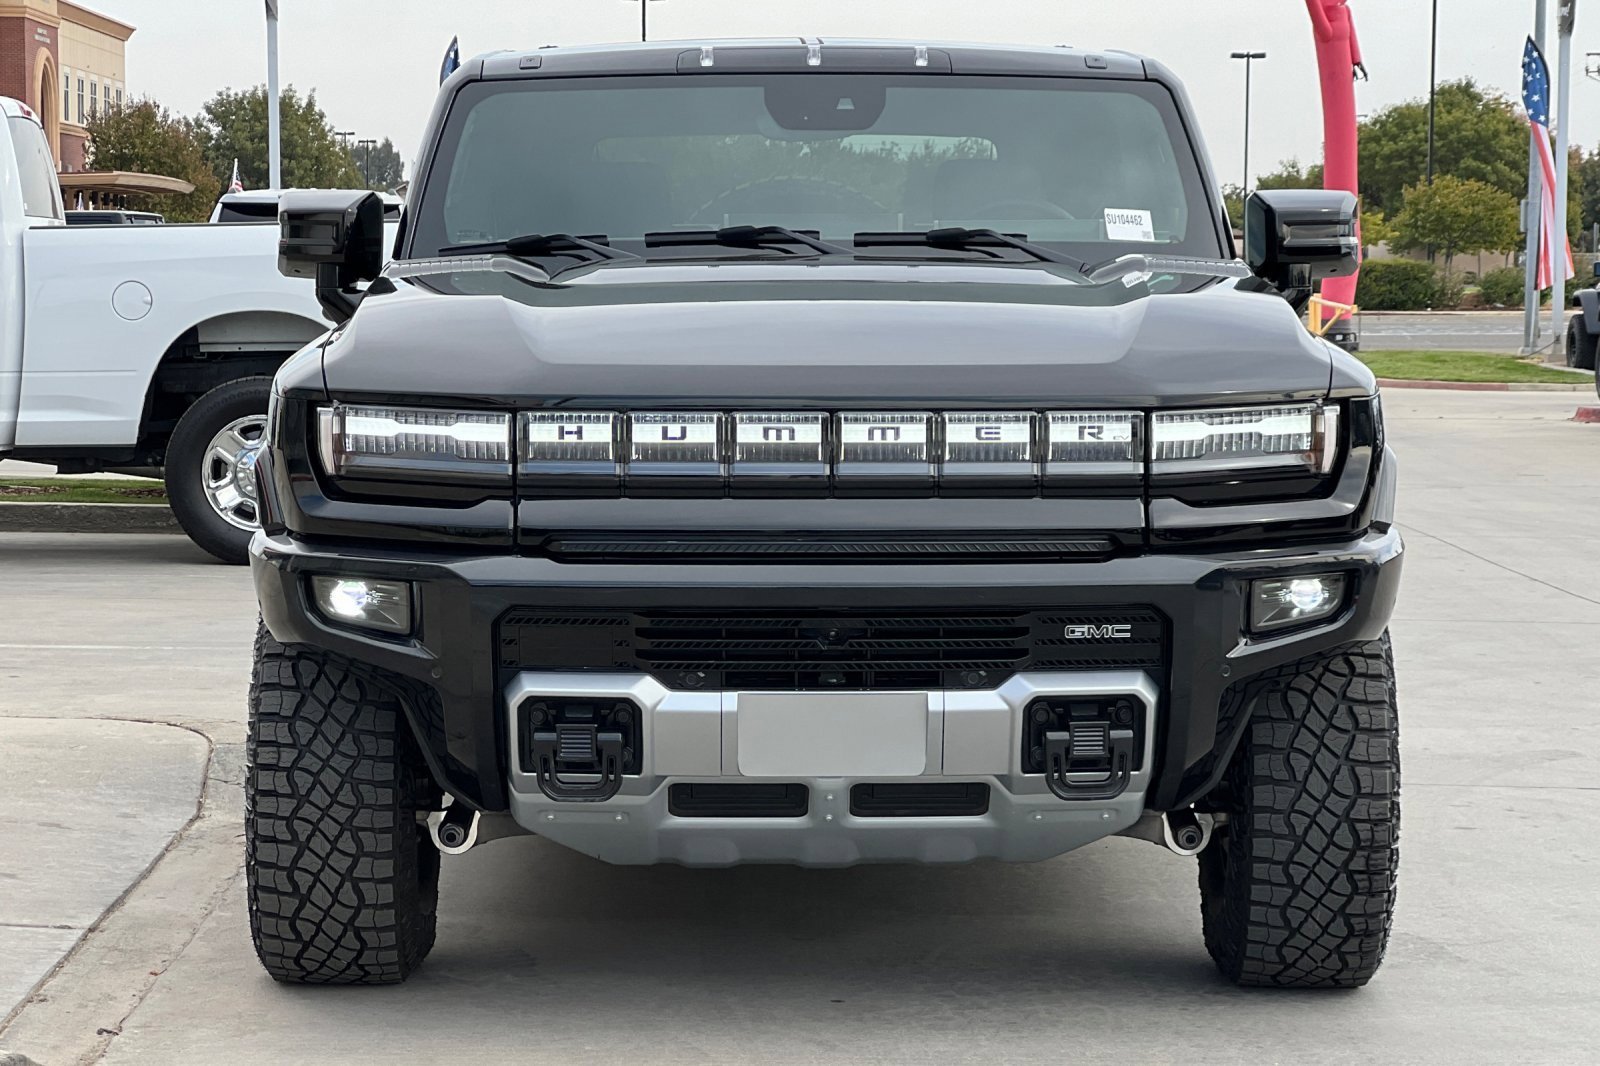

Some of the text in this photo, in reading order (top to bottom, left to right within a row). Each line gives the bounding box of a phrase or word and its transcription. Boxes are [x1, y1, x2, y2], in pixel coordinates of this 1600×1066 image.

[1106, 213, 1143, 226] SU104462
[558, 425, 1104, 441] HUMMER
[1064, 624, 1132, 639] GMC
